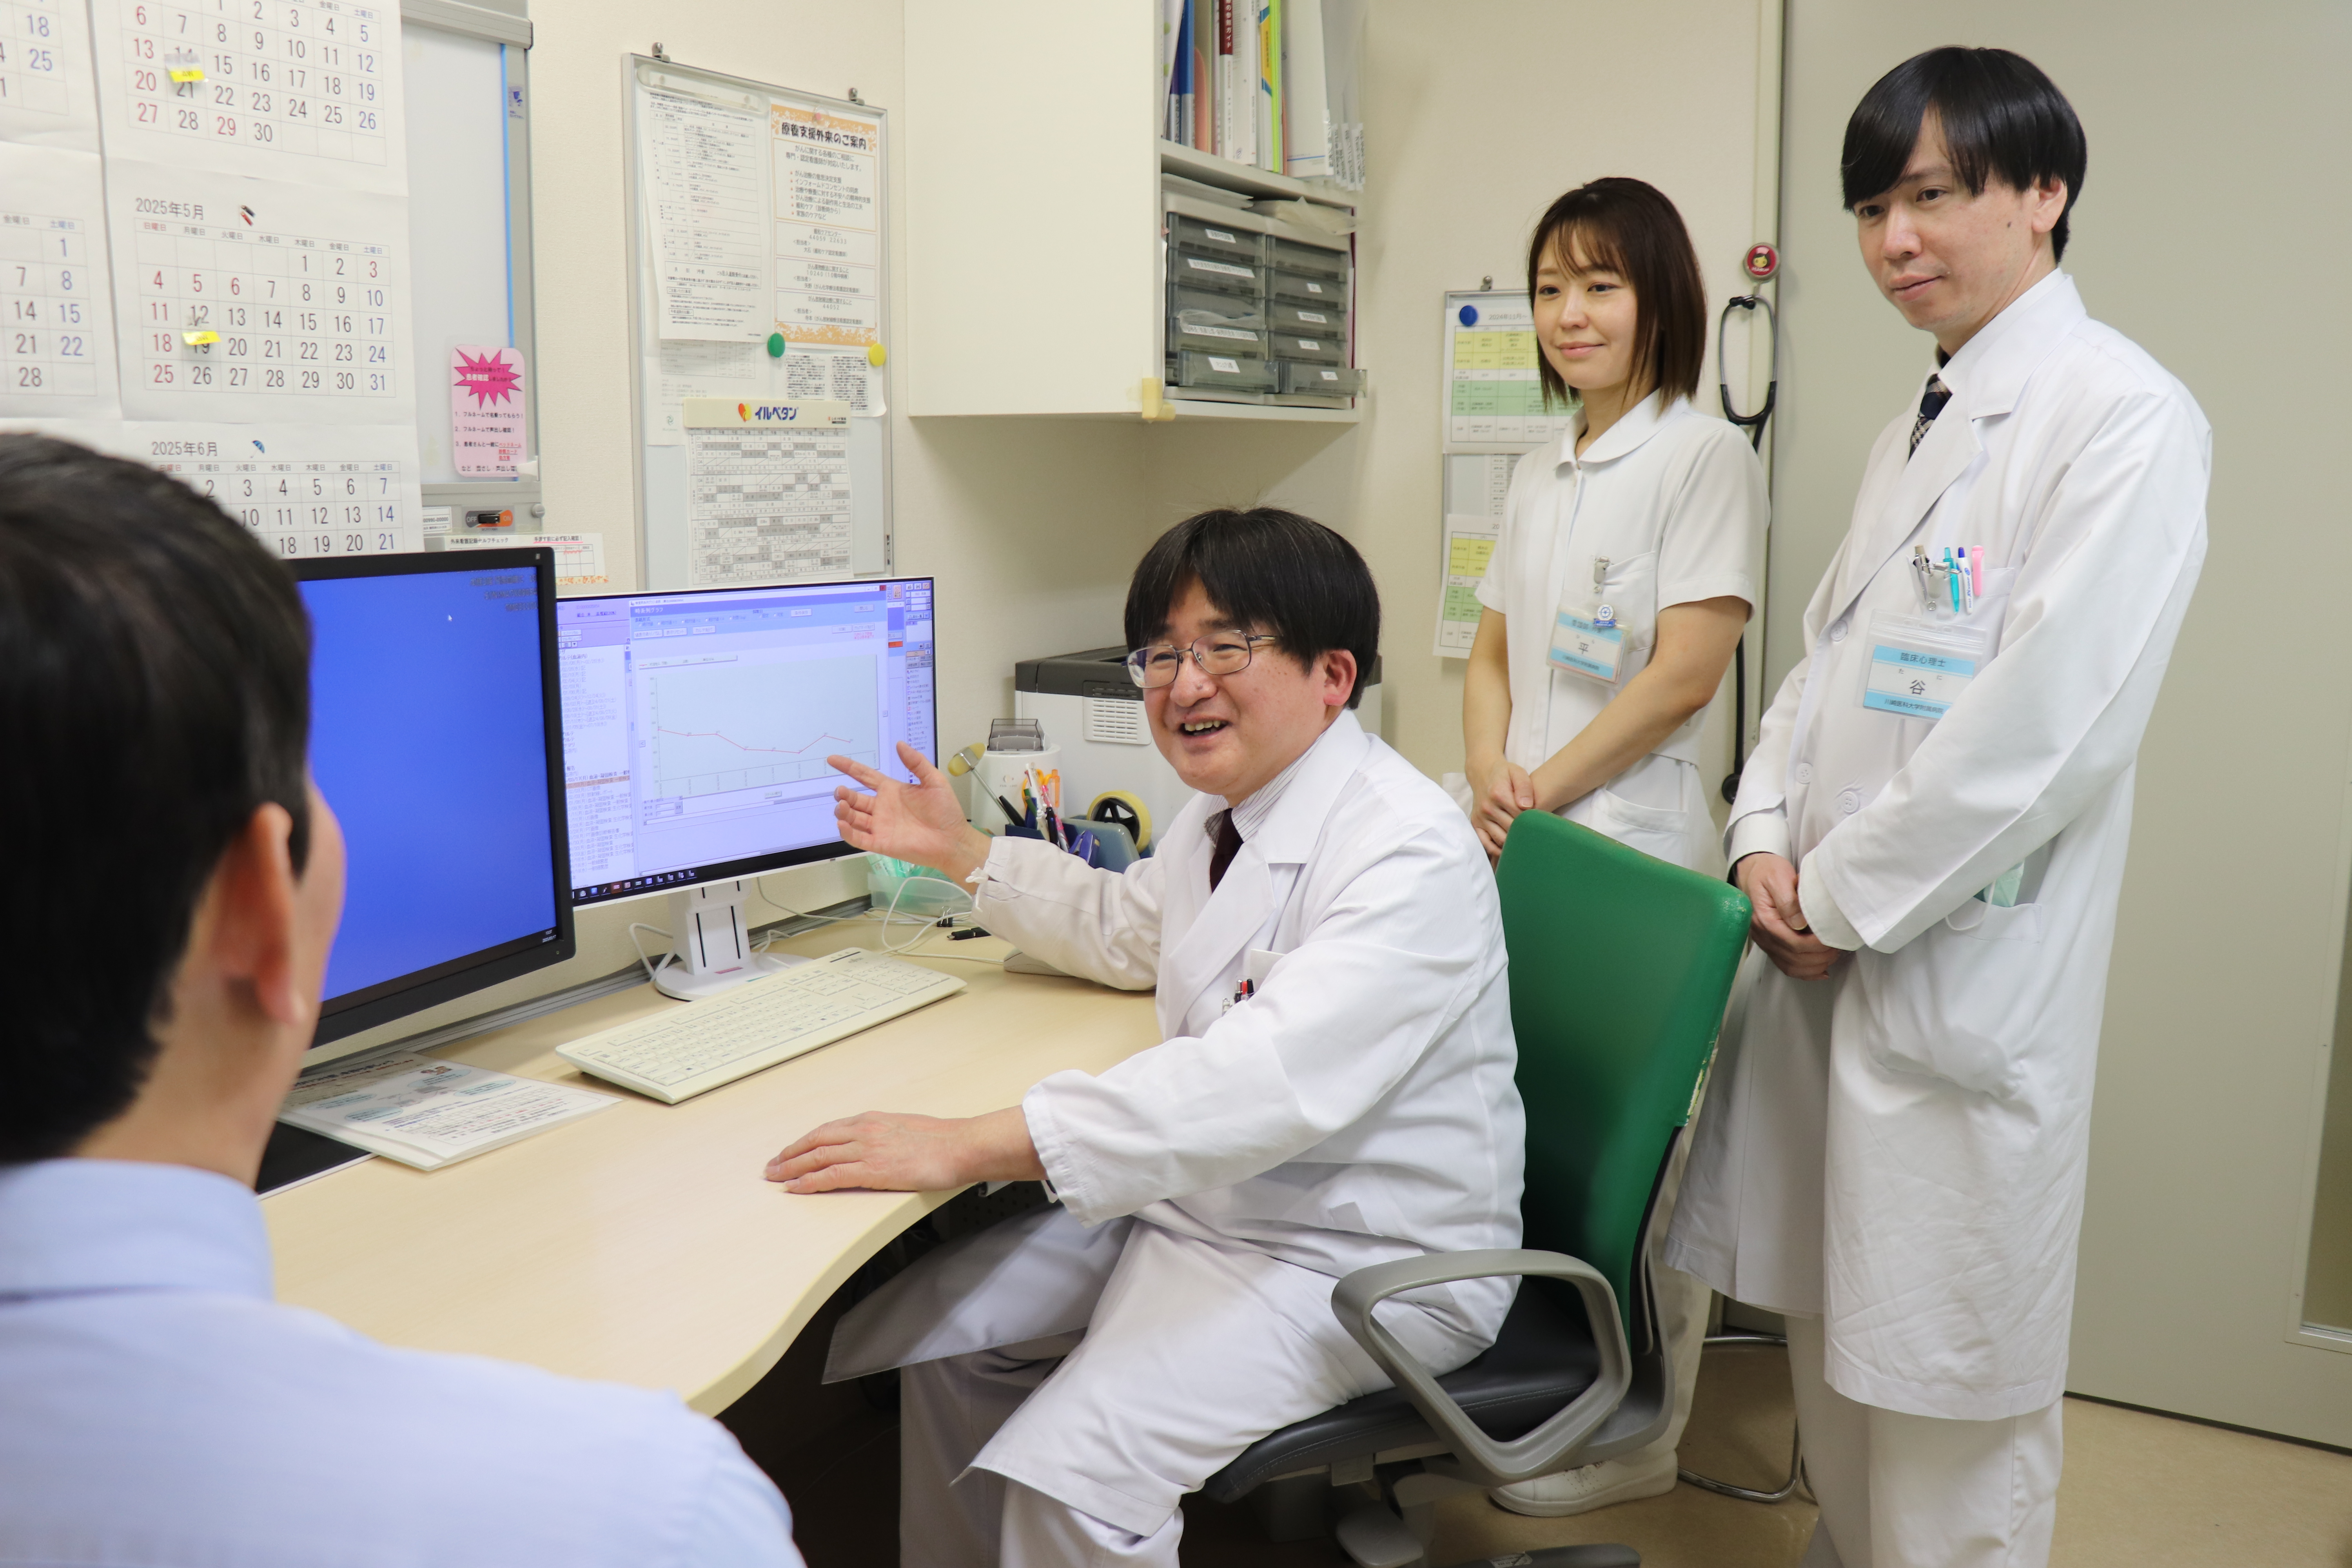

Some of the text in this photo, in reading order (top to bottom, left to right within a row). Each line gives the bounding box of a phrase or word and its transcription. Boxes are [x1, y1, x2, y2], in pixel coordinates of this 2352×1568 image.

[27, 15, 49, 37] 18
[254, 0, 263, 20] 2
[290, 9, 299, 27] 3
[326, 17, 335, 35] 4
[361, 24, 368, 42] 5
[135, 5, 374, 73] 6 7 8 9 10 11 12
[29, 48, 53, 71] 25
[134, 37, 375, 101] 13 15 16 17 18 19
[0, 78, 6, 97] 1
[135, 69, 156, 91] 20
[214, 85, 234, 106] 22
[252, 92, 271, 112] 23
[289, 98, 307, 118] 24
[325, 105, 342, 124] 25
[359, 111, 376, 130] 26
[137, 102, 272, 142] 27 28 29 30
[782, 122, 866, 150] 療養支援外来のご案内
[136, 198, 203, 220] 2025年5月
[60, 238, 67, 256] 1
[302, 254, 377, 278] 1 2 3
[16, 266, 72, 290] 7 8
[153, 270, 383, 307] 4 5 6 7 8 9 10
[15, 301, 80, 323] 14 15
[151, 302, 384, 334] 11 12 13 14 15 16 17
[15, 333, 83, 356] 21 22
[153, 333, 172, 352] 18
[229, 338, 247, 356] 20
[265, 339, 281, 358] 21
[300, 341, 319, 360] 22
[335, 343, 353, 361] 23
[369, 345, 386, 363] 24
[18, 367, 42, 387] 28
[153, 364, 385, 390] 25 26 27 28 29 30 31
[755, 407, 797, 420] イルベタン
[152, 442, 218, 456] 2025年6月
[243, 479, 252, 497] 3
[278, 479, 288, 496] 4
[313, 478, 322, 496] 5
[347, 478, 355, 495] 6
[379, 477, 387, 494] 7
[277, 508, 292, 525] 11
[311, 507, 328, 524] 12
[345, 506, 361, 523] 13
[377, 505, 395, 522] 14
[279, 533, 394, 554] 18 19 20 21
[1578, 642, 1589, 654] 平
[1900, 652, 1947, 667] 臨床心理士
[1909, 679, 1926, 695] 谷
